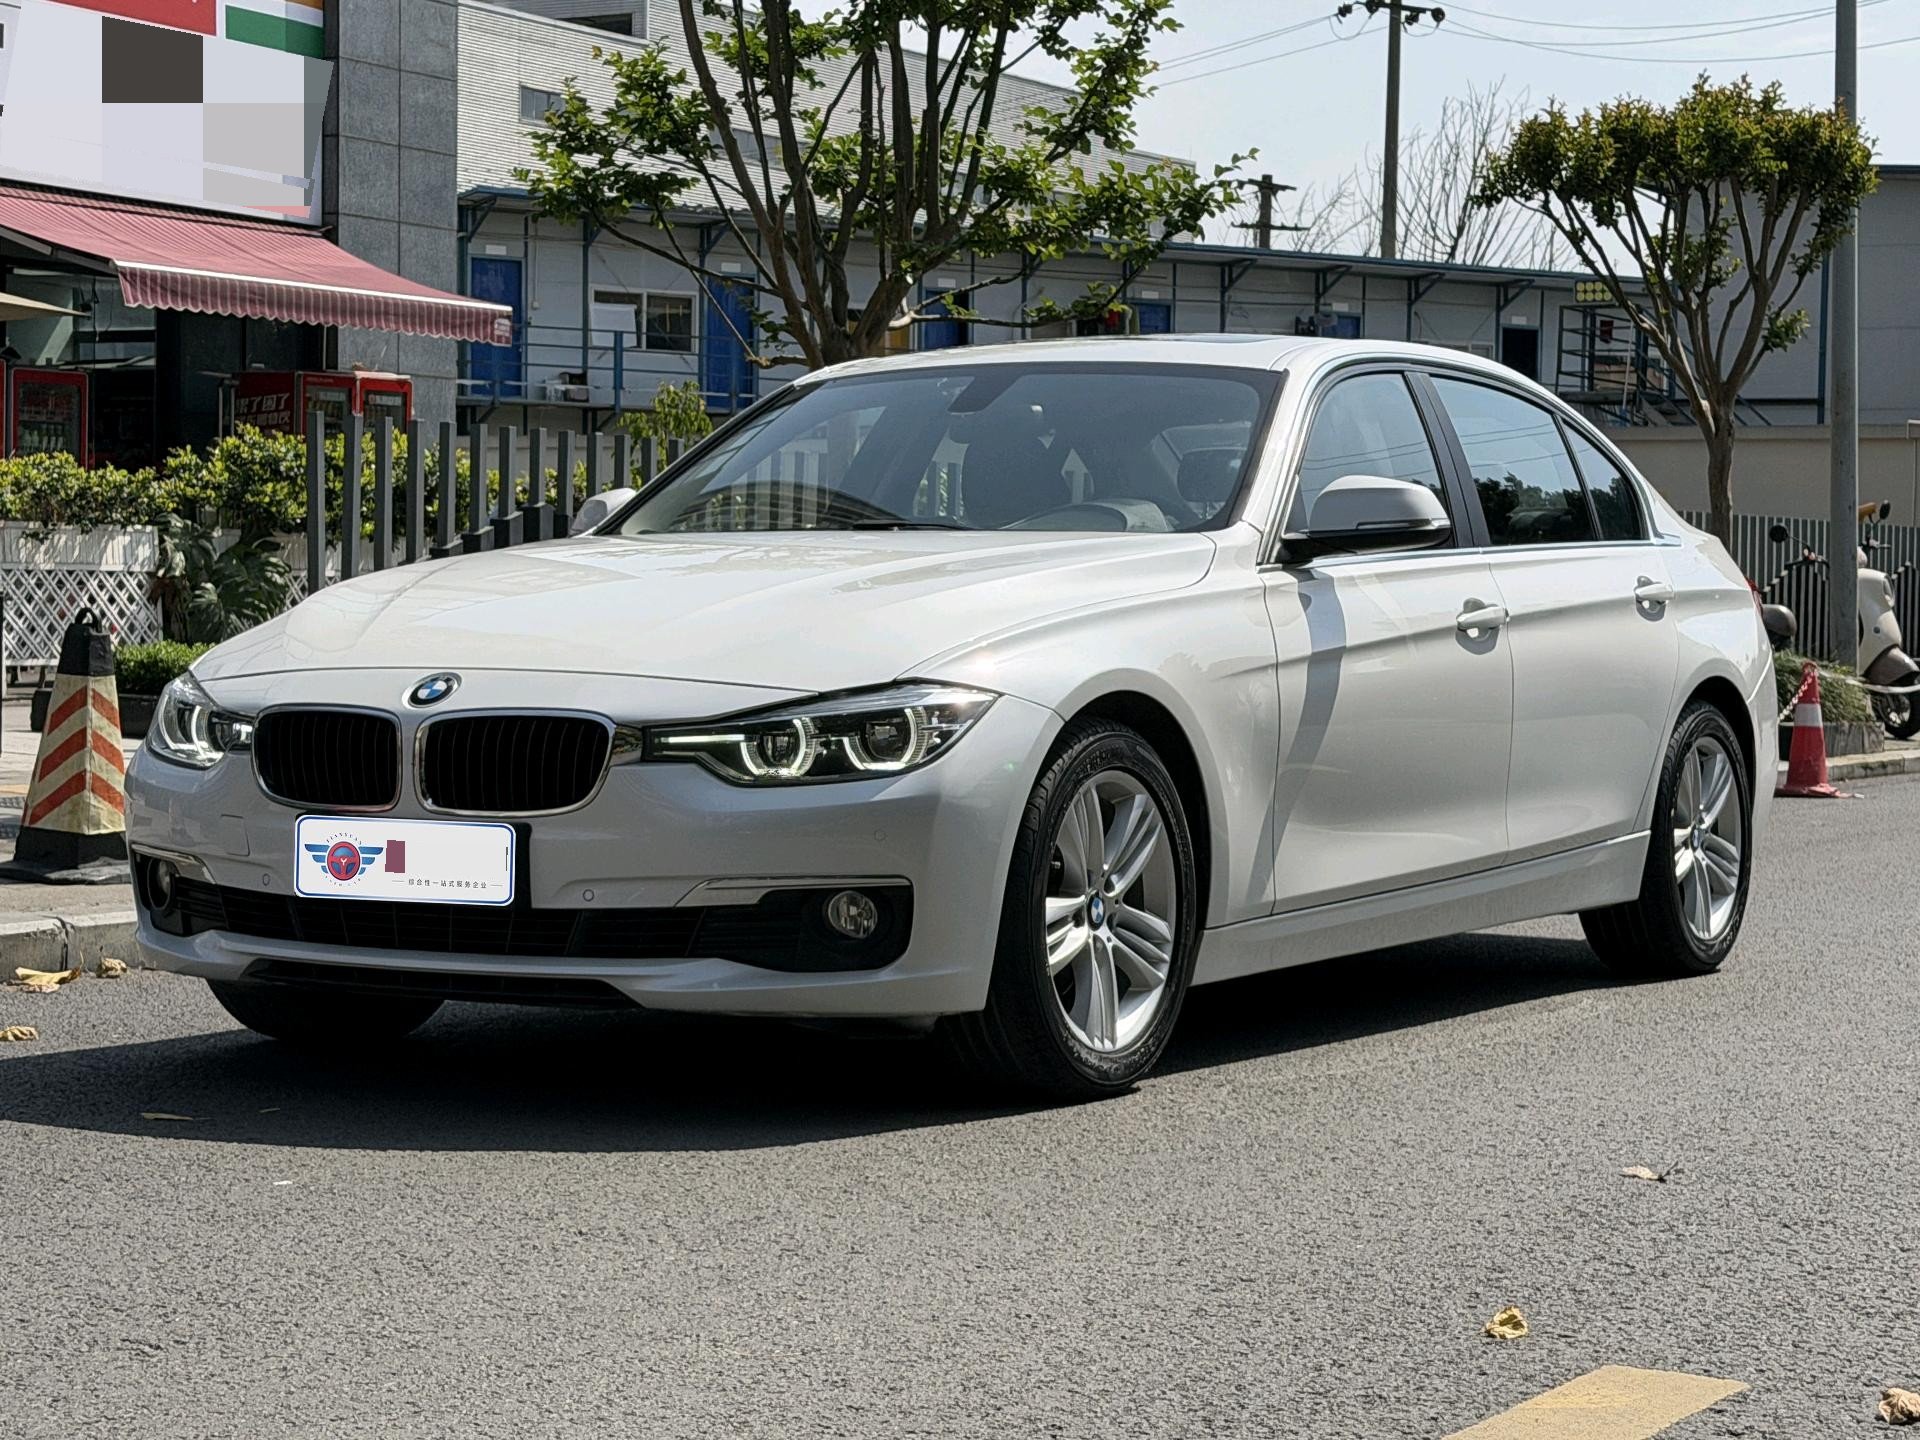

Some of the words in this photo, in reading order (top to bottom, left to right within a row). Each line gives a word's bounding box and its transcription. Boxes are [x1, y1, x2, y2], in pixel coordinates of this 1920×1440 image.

[408, 878, 487, 889] 综合性一站式服务企业
